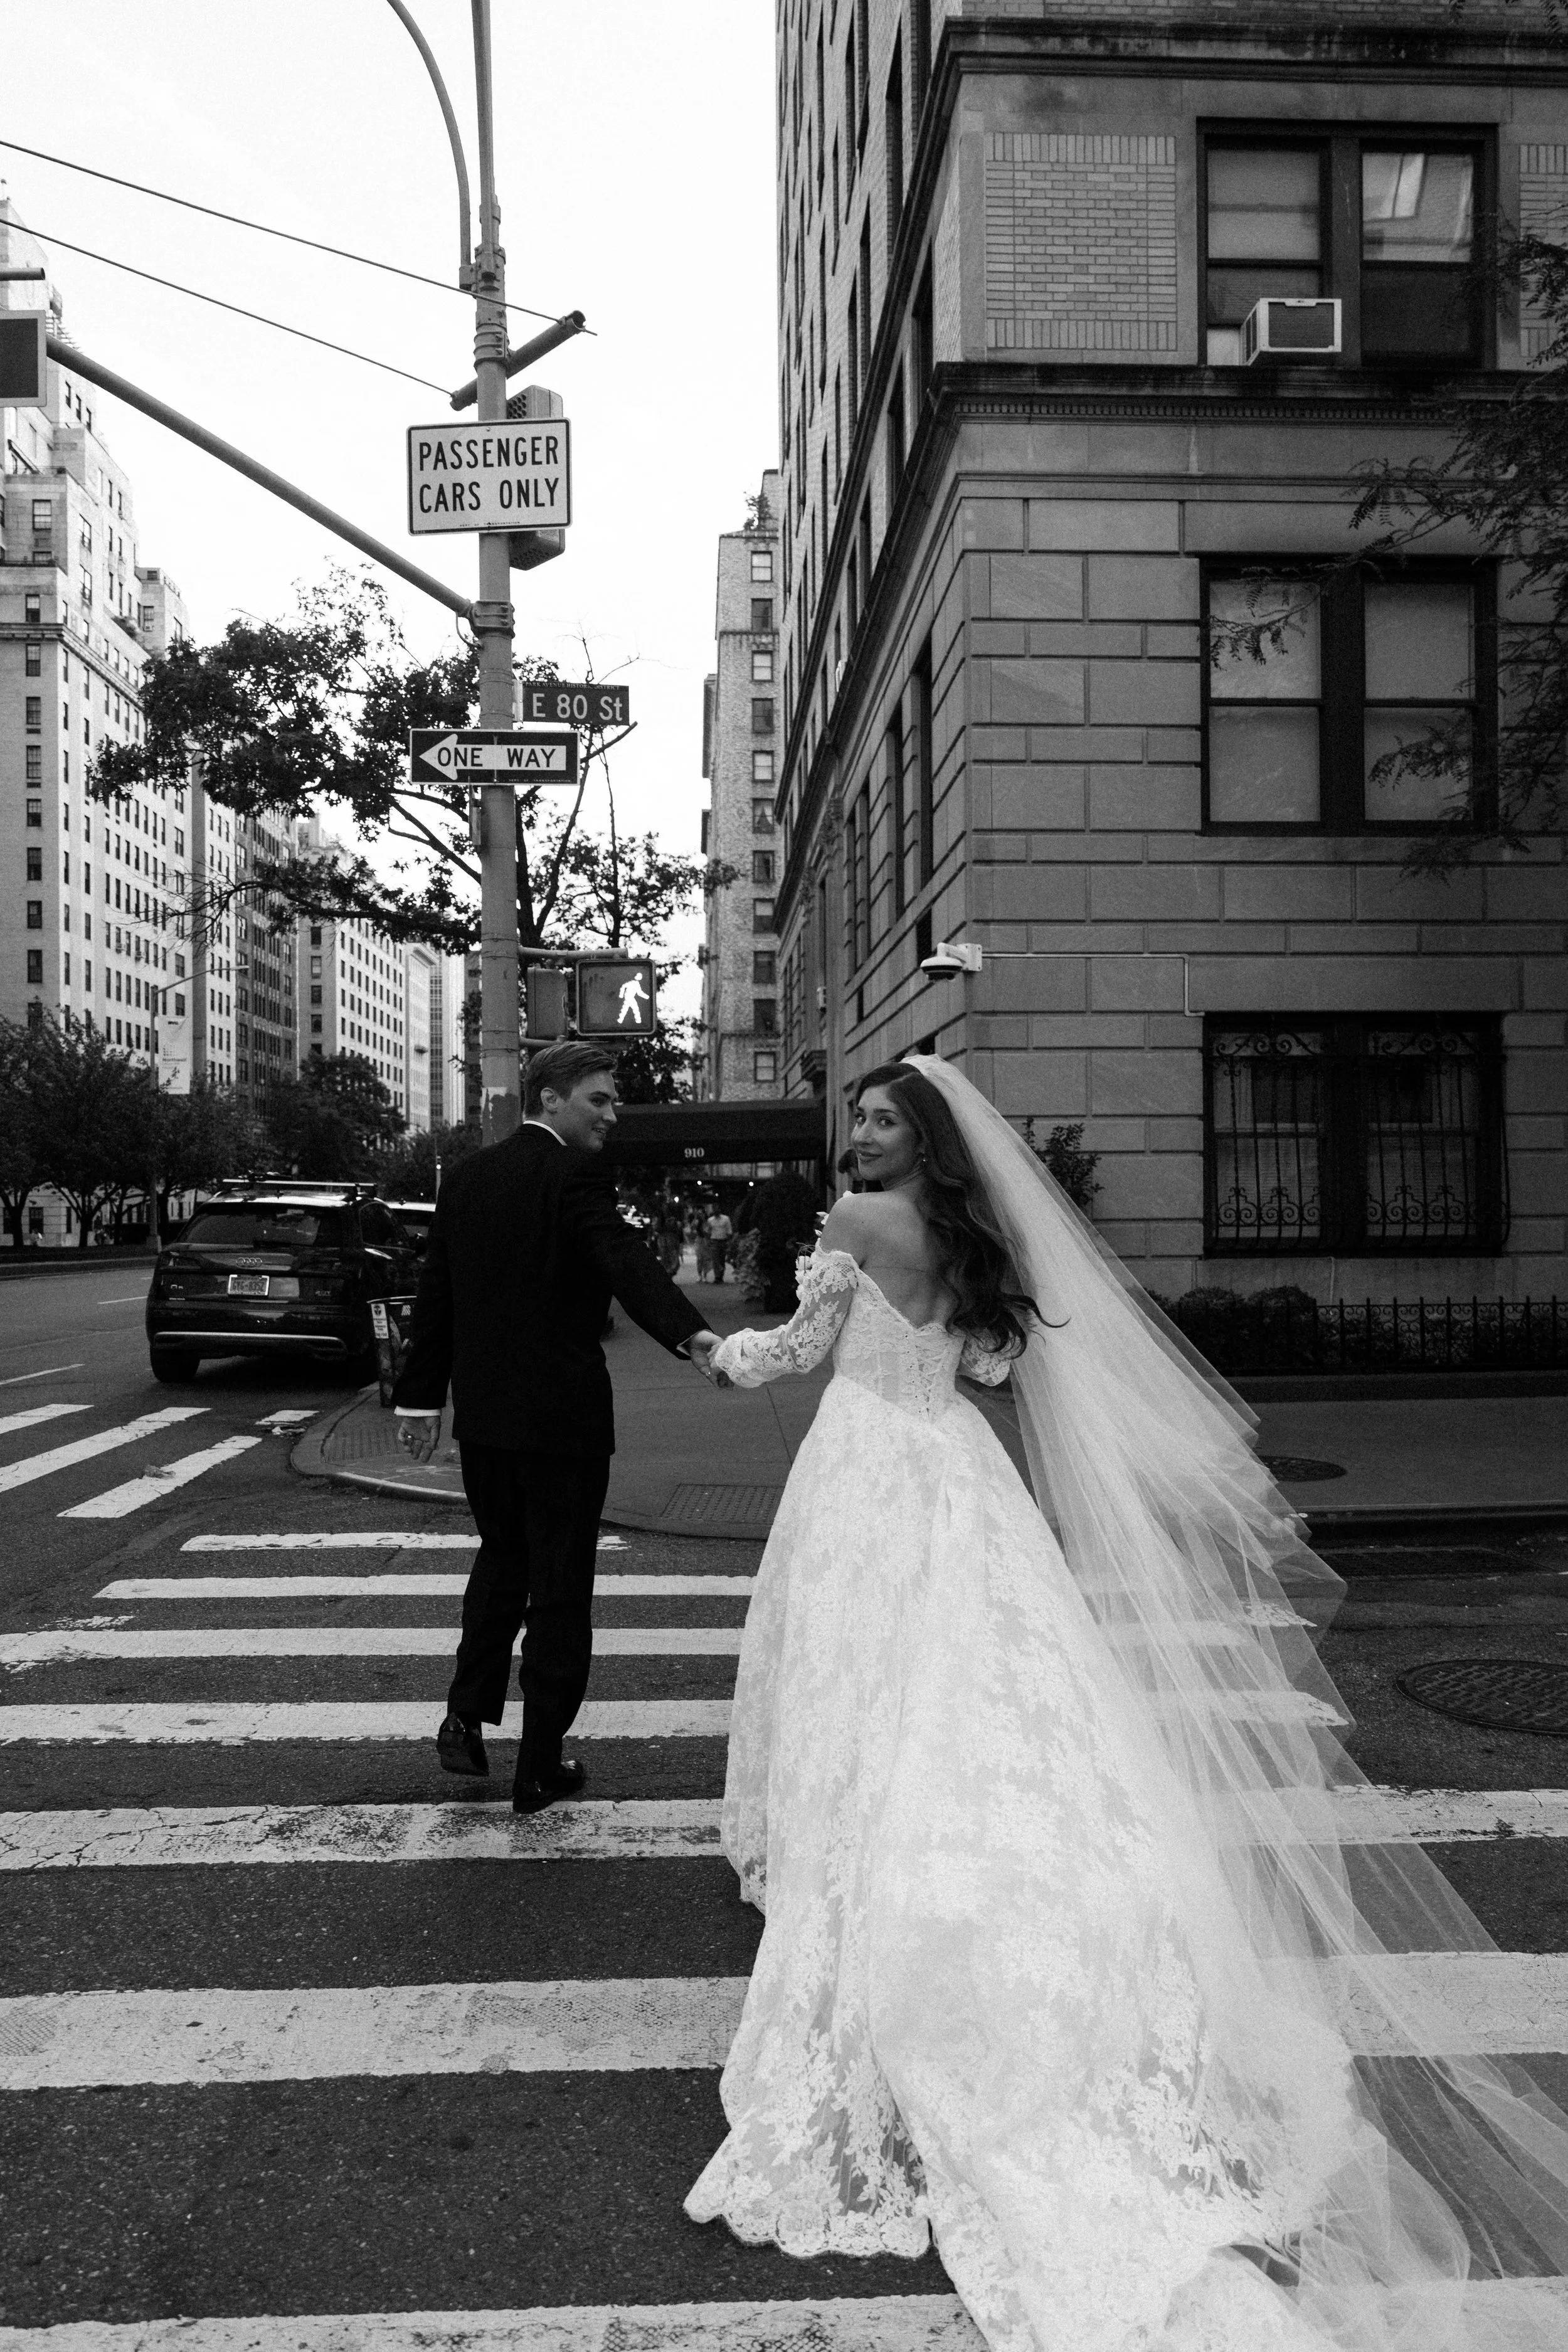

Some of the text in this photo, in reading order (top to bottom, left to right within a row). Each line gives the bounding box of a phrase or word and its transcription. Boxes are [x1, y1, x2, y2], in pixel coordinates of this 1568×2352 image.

[419, 436, 558, 471] PASSENGER
[420, 477, 559, 513] CARS ONLY
[532, 693, 623, 721] E 80 St
[437, 747, 556, 768] ONE WAY
[684, 1147, 705, 1158] 910
